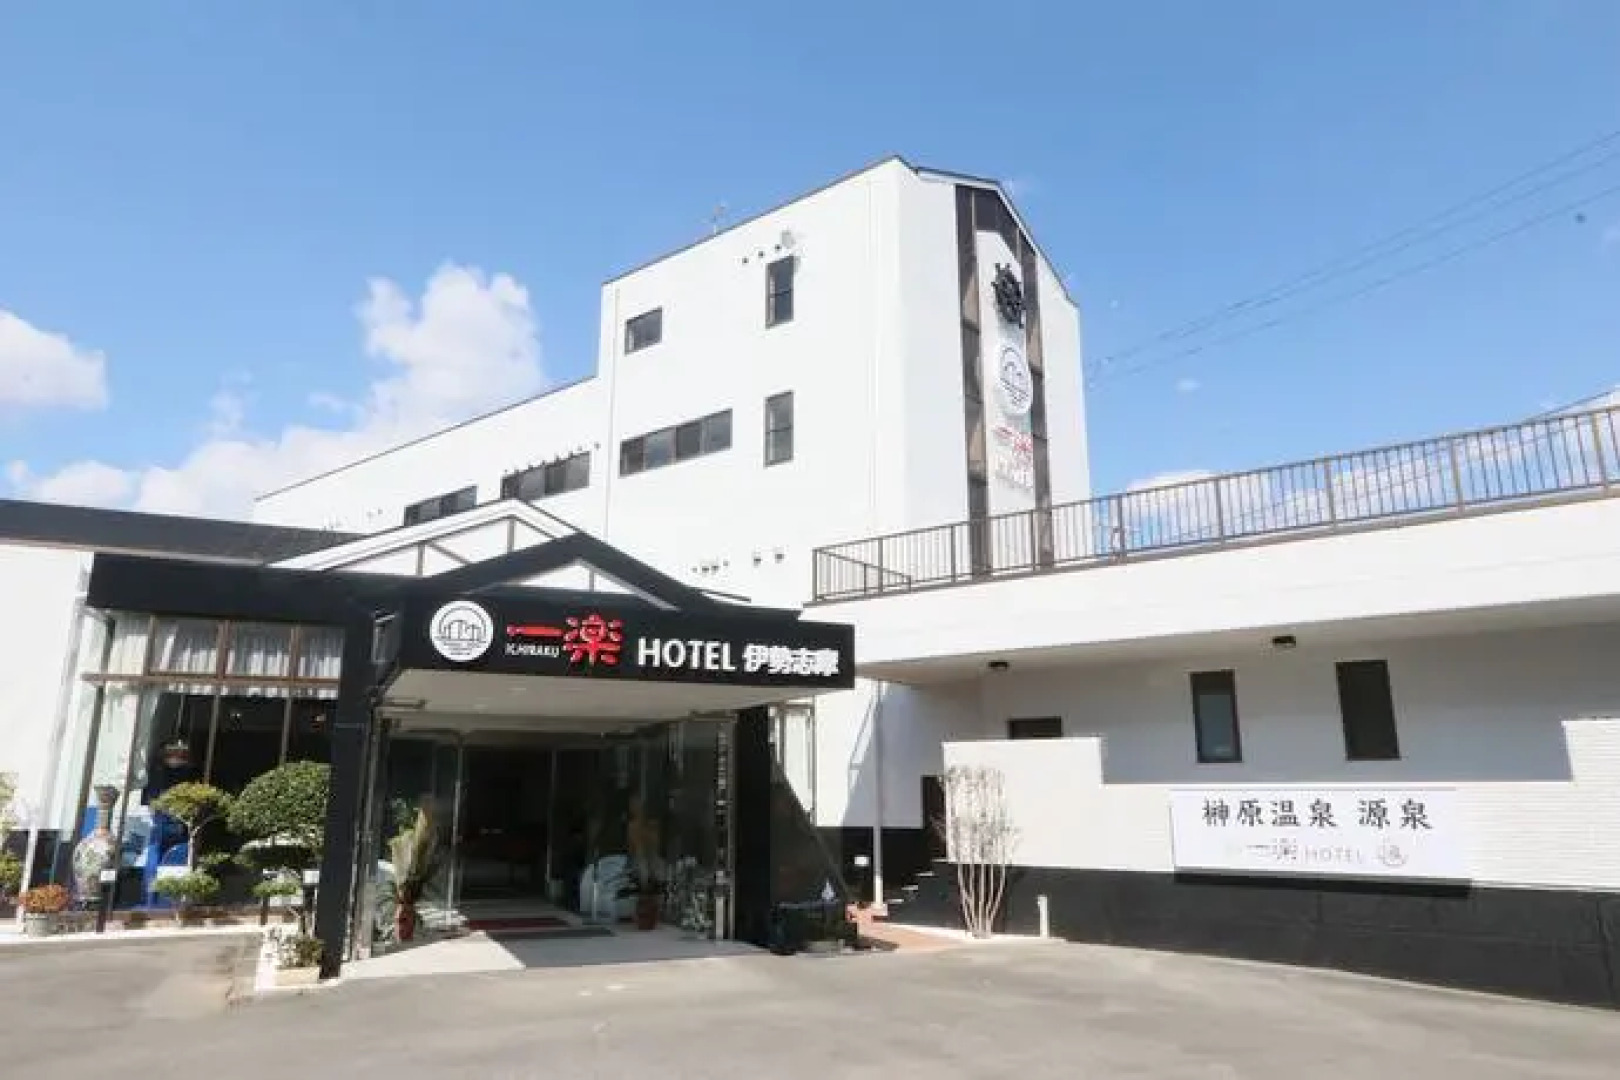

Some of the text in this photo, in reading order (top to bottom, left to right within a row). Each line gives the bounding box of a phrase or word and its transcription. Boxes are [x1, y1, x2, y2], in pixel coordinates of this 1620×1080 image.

[637, 637, 736, 671] HOTEL
[1202, 798, 1434, 830] 榊原温泉 源泉
